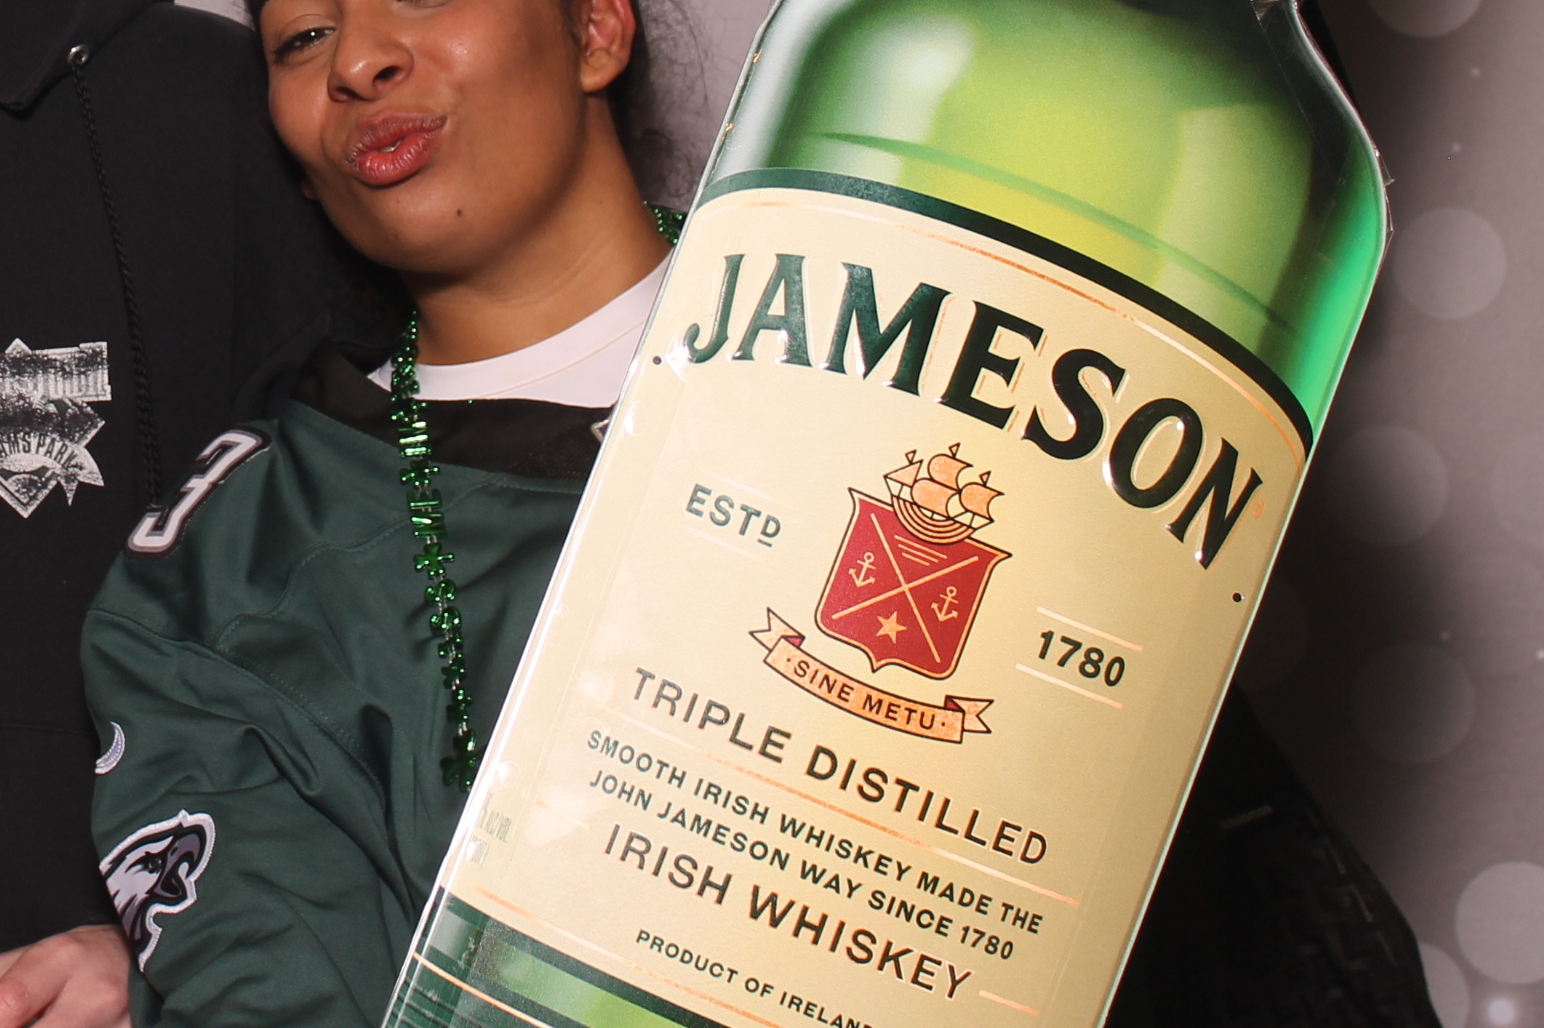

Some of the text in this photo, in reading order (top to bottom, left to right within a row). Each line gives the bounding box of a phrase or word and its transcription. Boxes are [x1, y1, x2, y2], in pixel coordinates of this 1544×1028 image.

[682, 252, 1264, 570] JAMESON
[793, 659, 936, 731] SINE METU
[1038, 629, 1126, 687] 1780
[587, 730, 1044, 935] SMOOTH IRISH WHISKEY MADE THE
[632, 667, 1048, 865] TRIPLE DISTILLED
[589, 770, 1015, 961] JOHN JAMESON WAY SINCE 1780
[604, 823, 973, 1001] IRISH WHISKEY
[635, 928, 874, 1028] PRODUCT OF IRELAN
